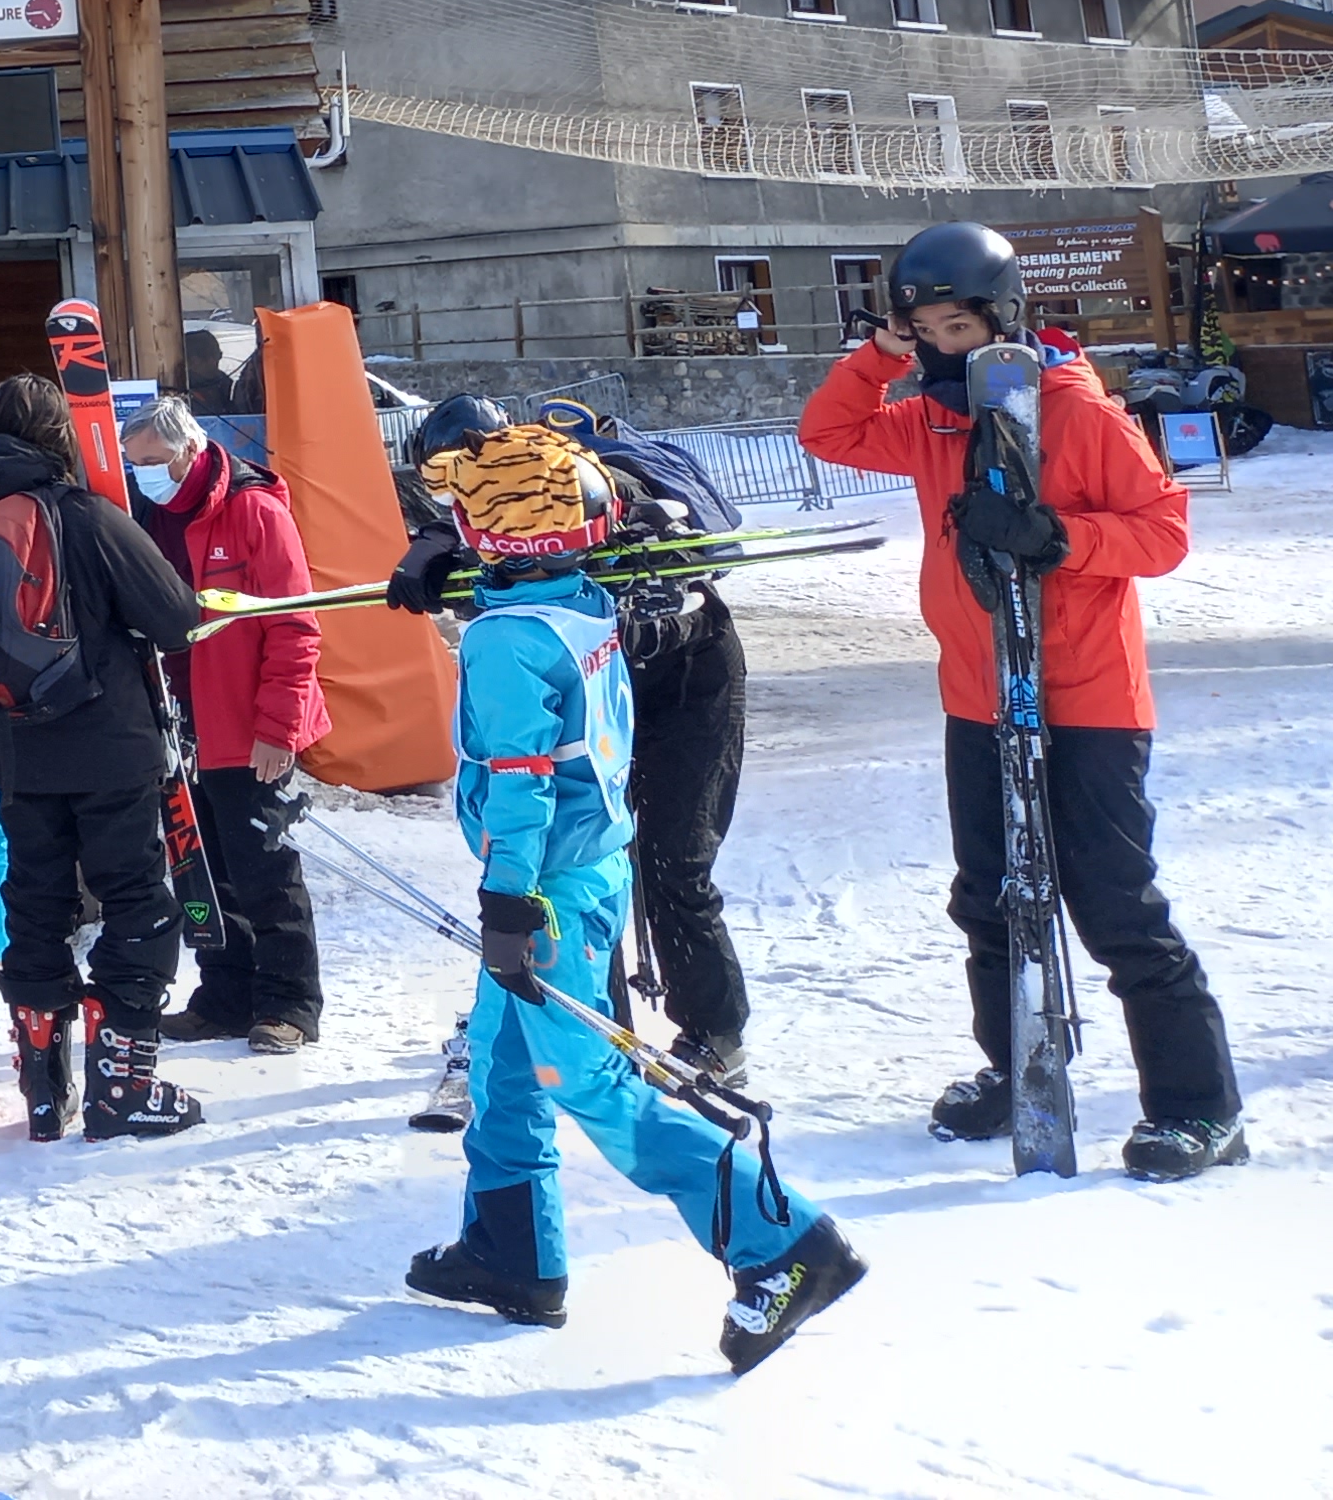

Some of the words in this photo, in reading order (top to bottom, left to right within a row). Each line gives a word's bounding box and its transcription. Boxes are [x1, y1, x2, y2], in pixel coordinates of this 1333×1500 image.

[1016, 250, 1122, 266] SEMBLEMENT
[1068, 264, 1103, 279] point
[1035, 282, 1069, 294] Cours
[1071, 278, 1128, 292] Collectifs
[495, 537, 563, 555] cairn
[127, 1111, 180, 1123] NORDICA
